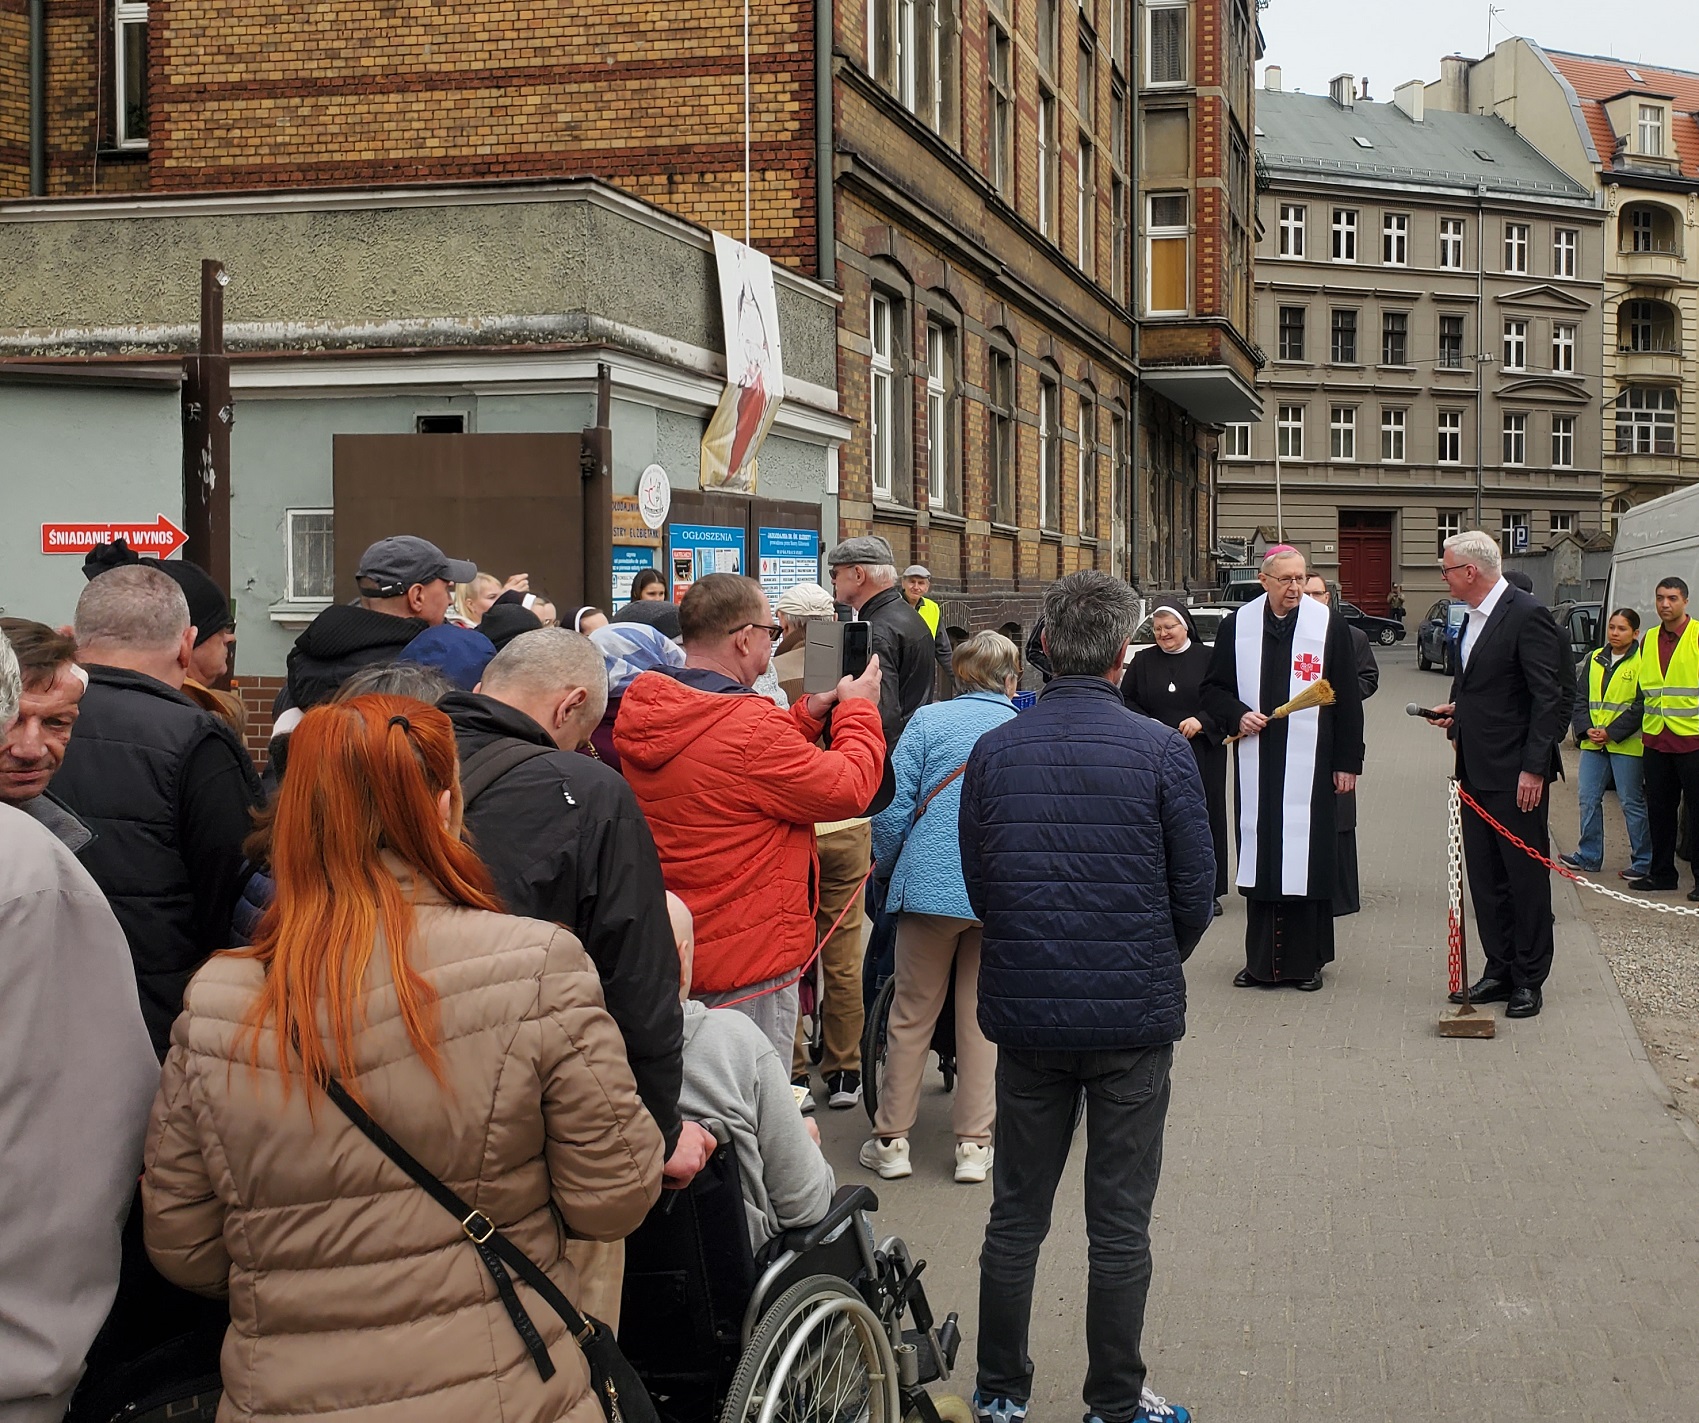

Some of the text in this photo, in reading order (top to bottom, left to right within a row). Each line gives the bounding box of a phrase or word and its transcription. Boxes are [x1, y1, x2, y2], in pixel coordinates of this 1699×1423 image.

[48, 528, 174, 545] ŚNIADANIE NA WYNOS
[682, 530, 733, 542] OGŁOSZENIA
[1516, 528, 1526, 545] P
